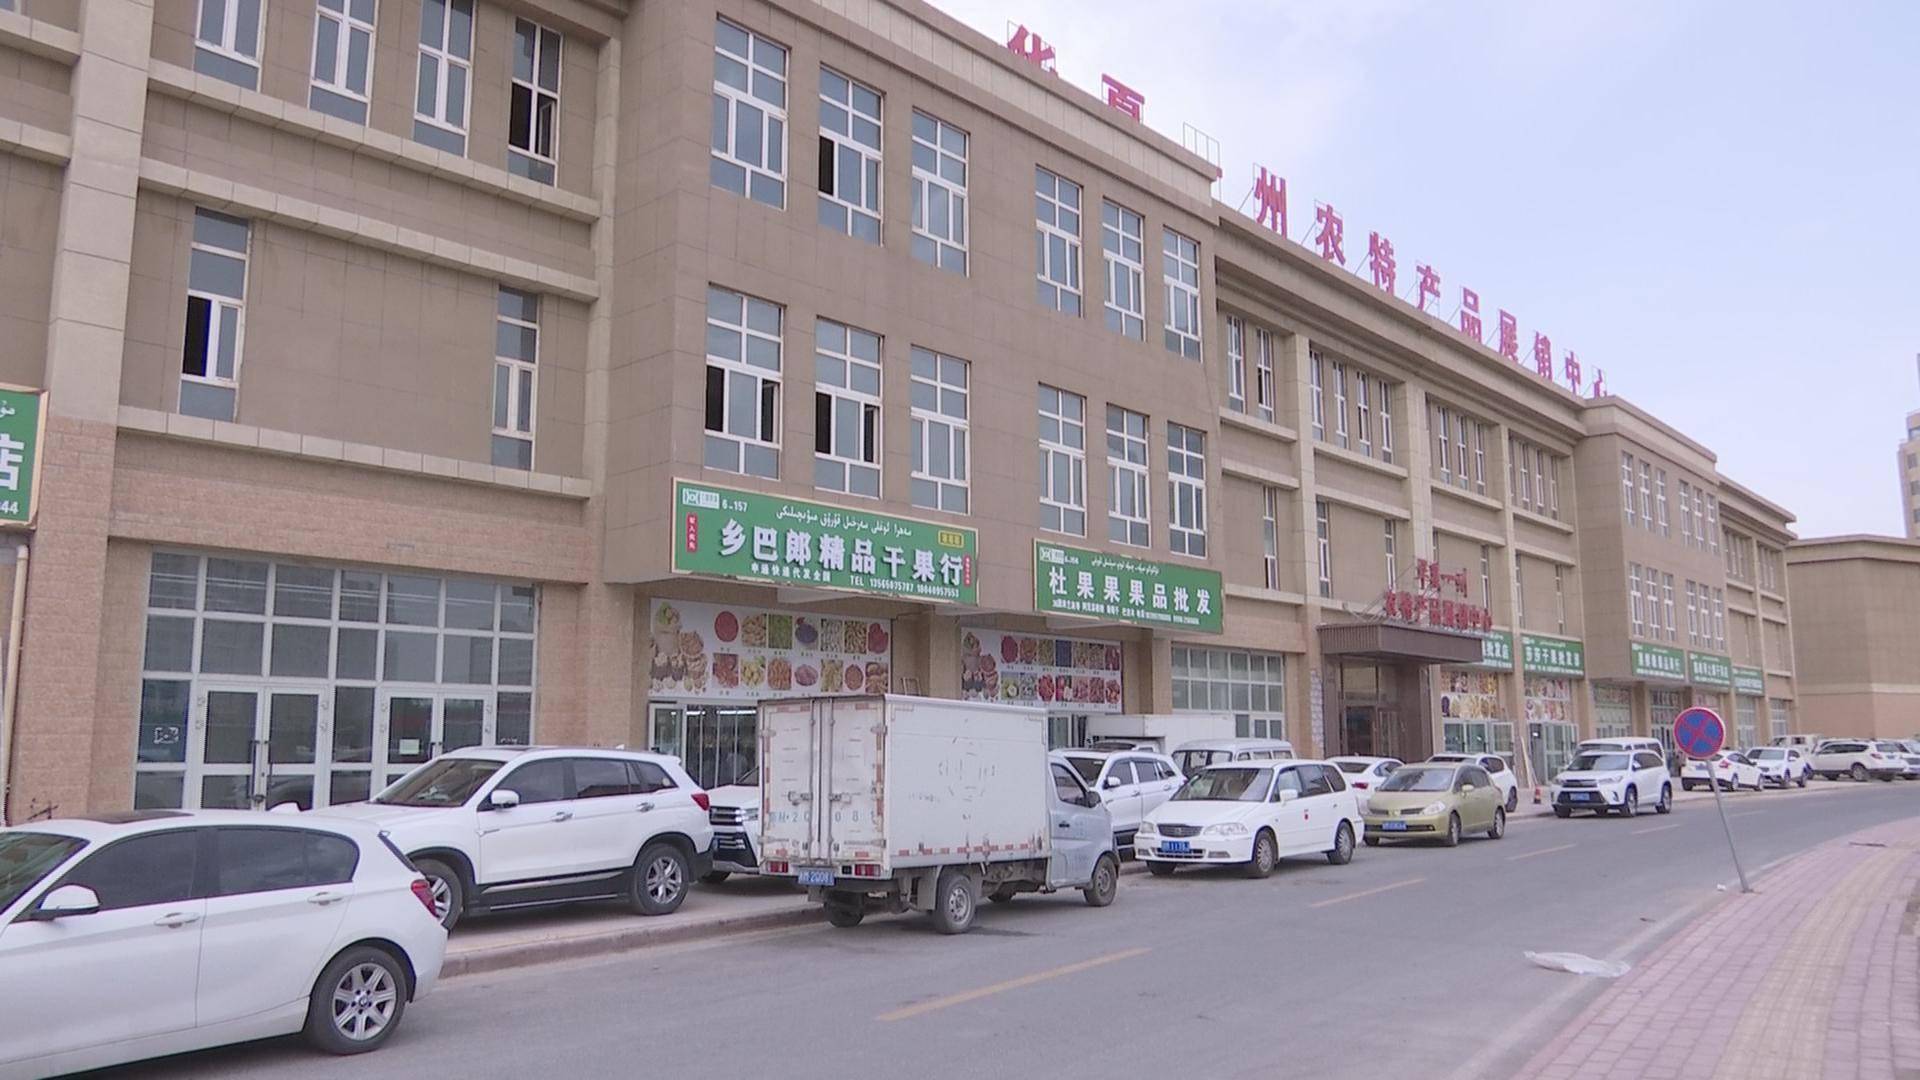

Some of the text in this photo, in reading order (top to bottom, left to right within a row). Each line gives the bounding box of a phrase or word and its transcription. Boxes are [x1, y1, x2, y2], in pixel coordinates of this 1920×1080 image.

[720, 518, 962, 586] 乡巴郎精品干果行
[850, 575, 864, 587] TEL
[1049, 566, 1211, 615] 杜果果果品批发
